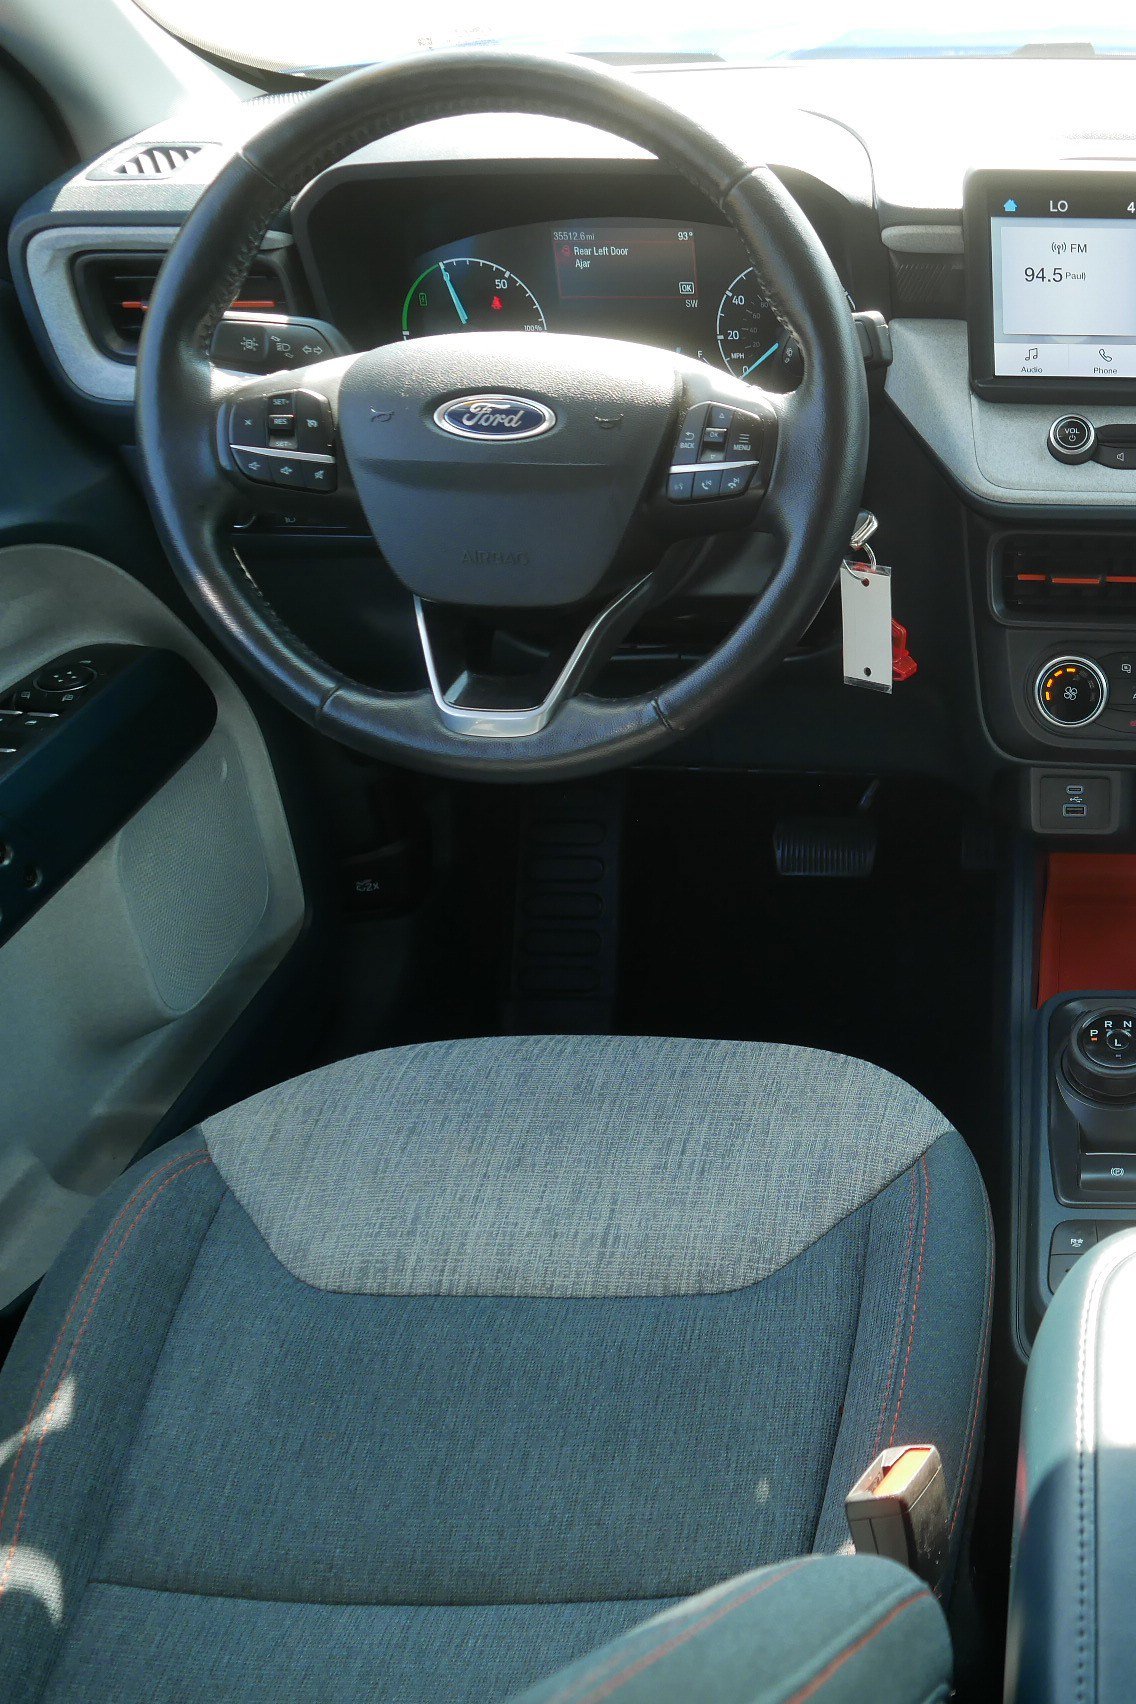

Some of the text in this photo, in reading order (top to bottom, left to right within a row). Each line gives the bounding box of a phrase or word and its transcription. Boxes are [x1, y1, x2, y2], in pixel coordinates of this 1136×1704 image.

[1049, 200, 1069, 213] LO
[553, 231, 595, 241] 35512.6 mi
[677, 231, 694, 241] 93°
[573, 246, 629, 256] Rear Left Door
[1070, 244, 1087, 253] FM
[575, 259, 591, 270] Ajar
[1024, 267, 1086, 283] 94.5 Paul)
[495, 279, 508, 289] 50
[681, 284, 692, 292] OK
[685, 300, 698, 308] SW
[732, 295, 745, 305] 40
[727, 331, 739, 340] 20
[1021, 366, 1043, 374] Audio
[1093, 367, 1118, 375] Phone
[461, 402, 526, 429] Ford
[1104, 1020, 1113, 1028] R
[1123, 1020, 1132, 1028] N
[1090, 1029, 1099, 1037] P
[1114, 1038, 1122, 1047] L
